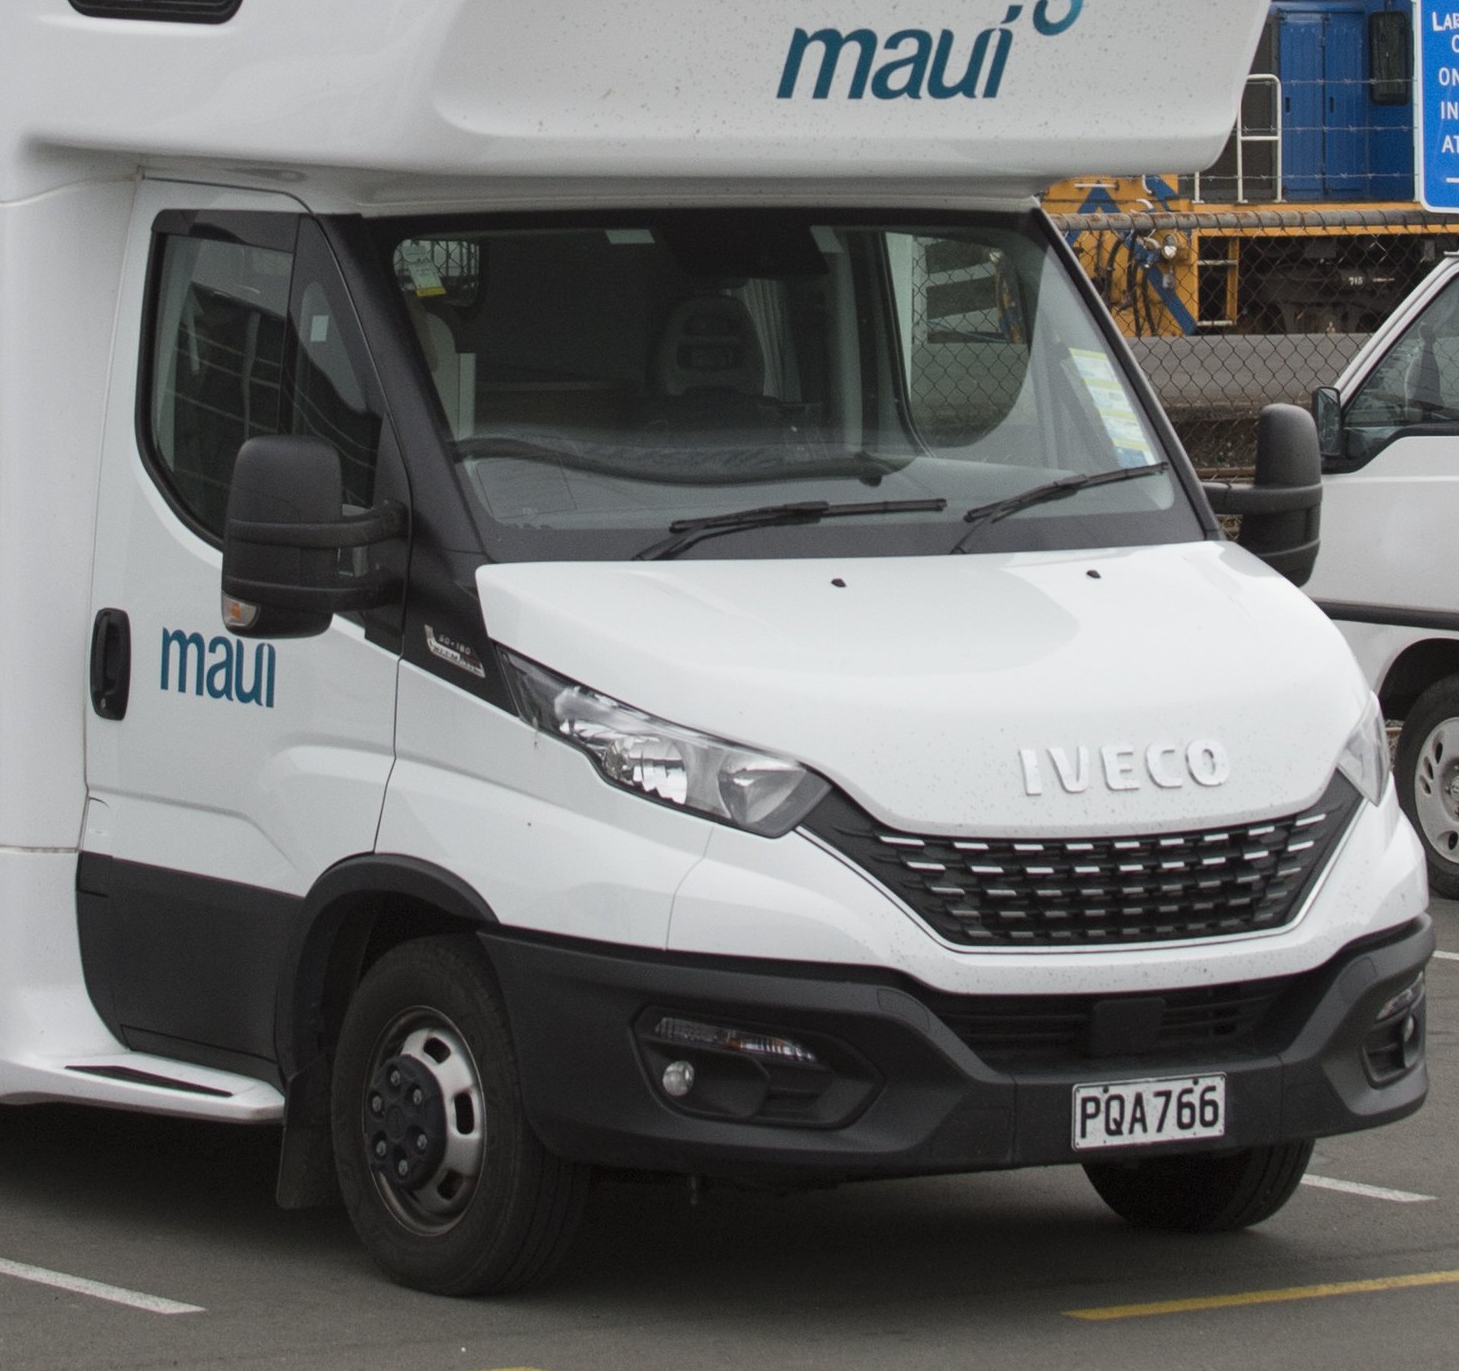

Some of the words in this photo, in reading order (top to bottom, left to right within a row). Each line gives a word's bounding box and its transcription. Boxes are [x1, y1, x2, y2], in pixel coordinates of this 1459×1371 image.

[776, 4, 1024, 100] maui
[1440, 101, 1459, 121] IN
[160, 626, 276, 709] maui
[1018, 738, 1232, 796] IVECO
[1079, 1083, 1221, 1140] PQA766
